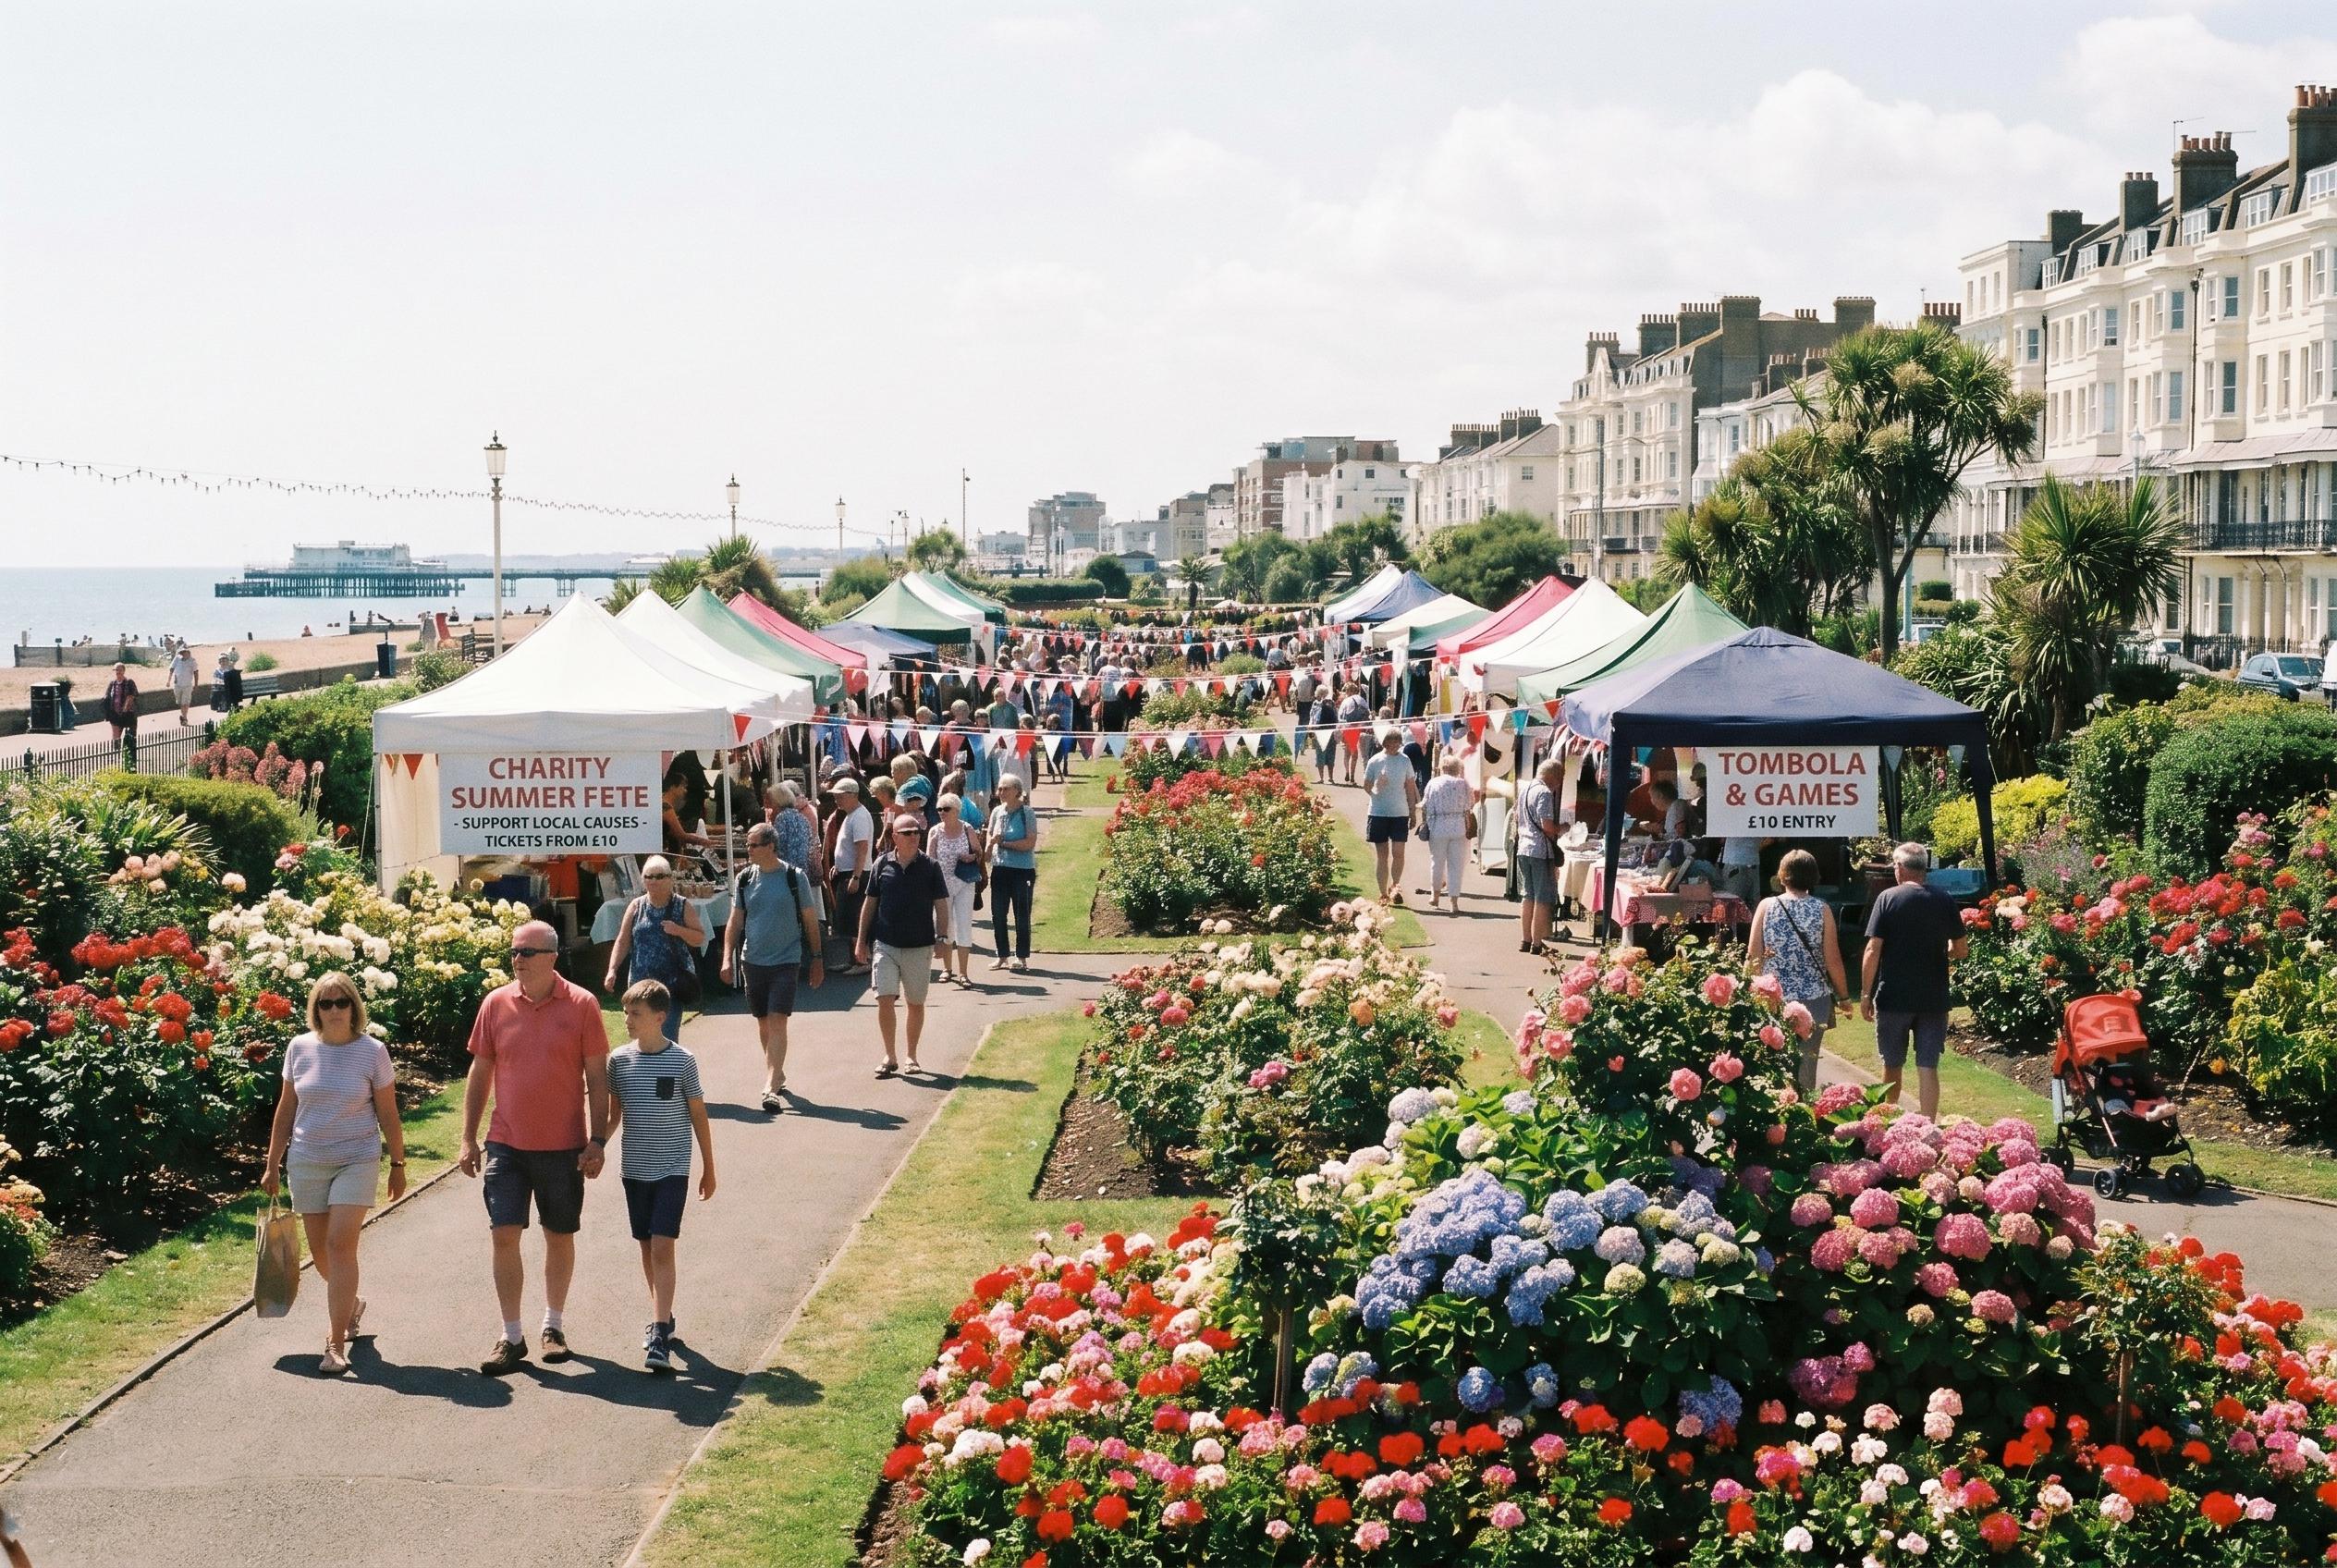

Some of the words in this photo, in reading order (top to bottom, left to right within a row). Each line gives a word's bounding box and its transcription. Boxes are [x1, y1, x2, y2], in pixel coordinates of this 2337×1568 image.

[488, 756, 611, 780] CHARITY
[1718, 752, 1867, 776] TOMBOLA
[451, 786, 577, 810] SUMMER
[583, 785, 650, 809] FETE
[1725, 782, 1747, 807] &
[1754, 782, 1860, 806] GAMES
[462, 816, 529, 830] SUPPORT
[532, 816, 581, 829] LOCAL
[582, 815, 639, 829] CAUSES
[1747, 815, 1779, 829] £10
[1782, 815, 1837, 829] ENTRY
[483, 835, 543, 848] TICKETS
[545, 834, 588, 848] FROM
[592, 835, 618, 847] £10
